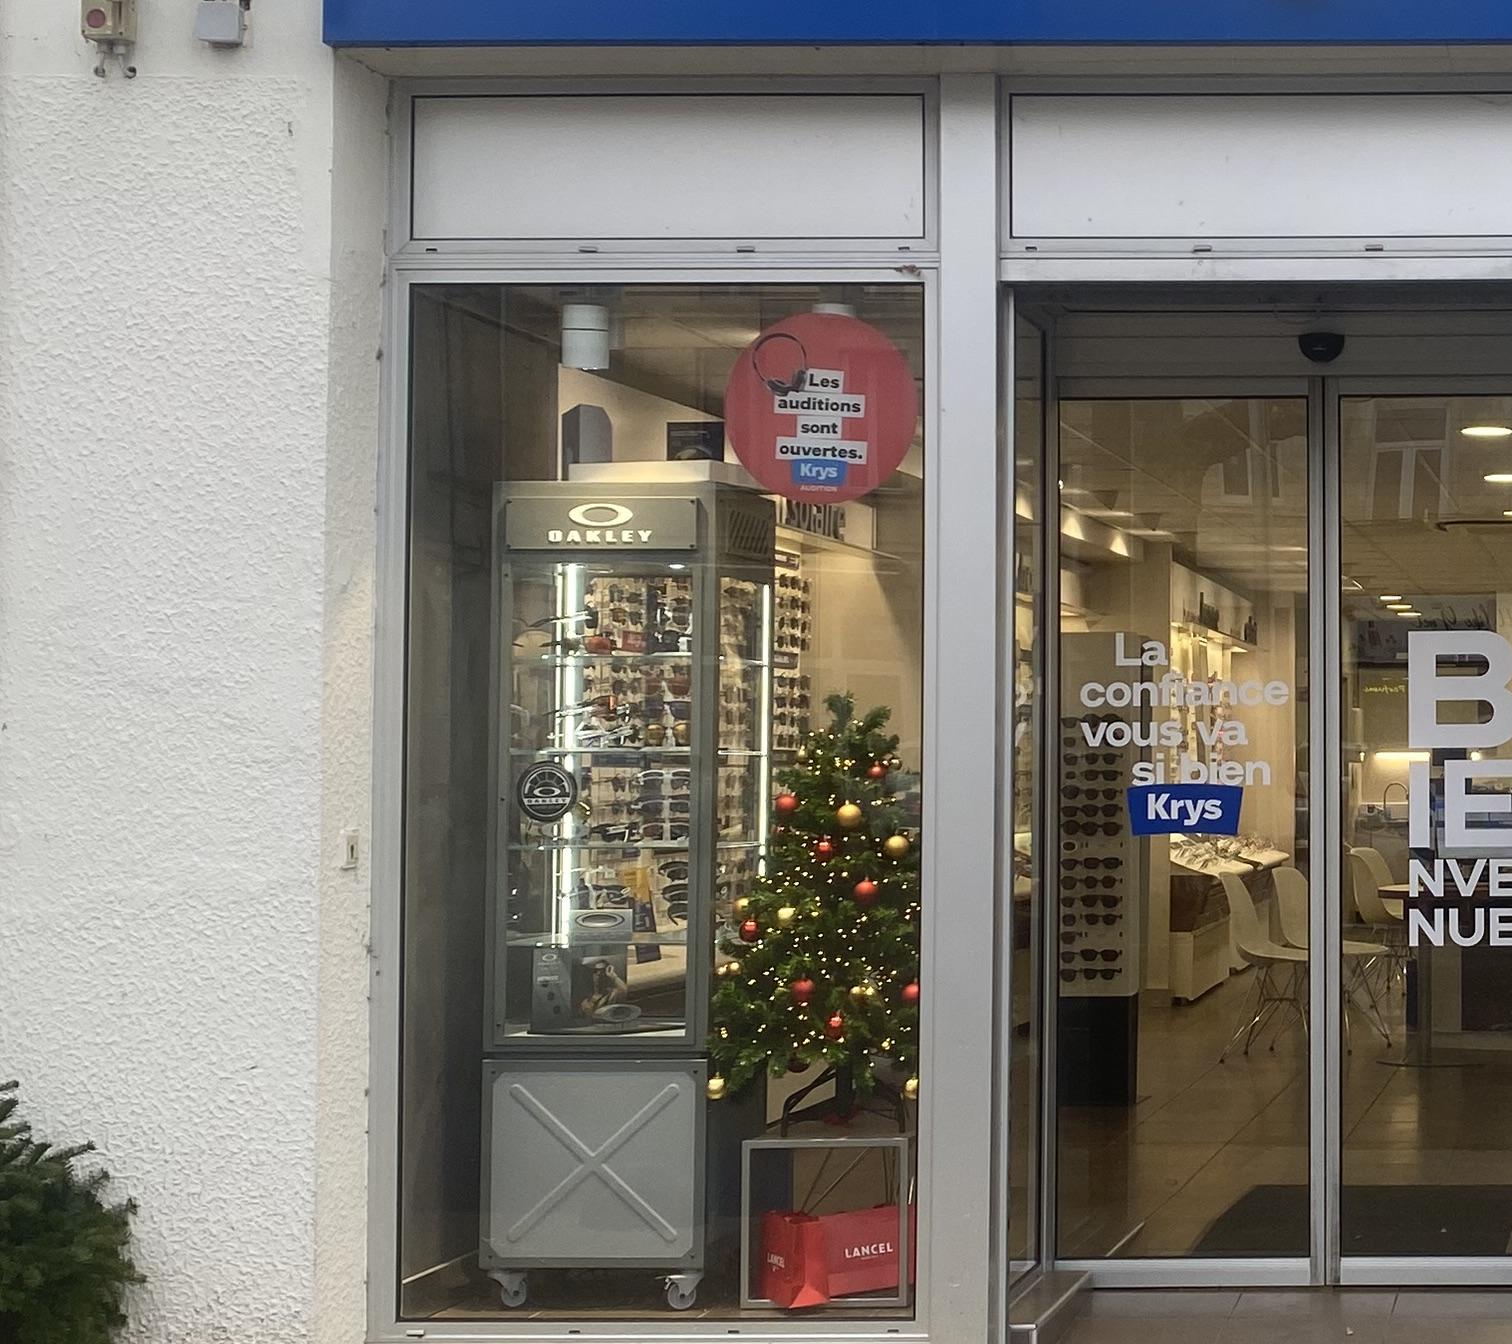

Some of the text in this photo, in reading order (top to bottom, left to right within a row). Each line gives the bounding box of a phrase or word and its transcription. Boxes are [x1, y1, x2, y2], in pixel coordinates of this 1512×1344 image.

[808, 373, 840, 389] Les
[777, 397, 862, 413] auditions
[800, 422, 838, 435] sont
[779, 444, 863, 460] ouvertes.
[799, 463, 838, 480] Krys
[547, 529, 654, 544] OAKLEY
[1115, 632, 1169, 667] La
[1079, 672, 1290, 709] confiance
[1080, 719, 1249, 748] vous va
[1131, 752, 1272, 787] si bien
[1147, 793, 1223, 826] Krys
[844, 1241, 894, 1259] LANCEL
[767, 1252, 785, 1268] LANCEL
